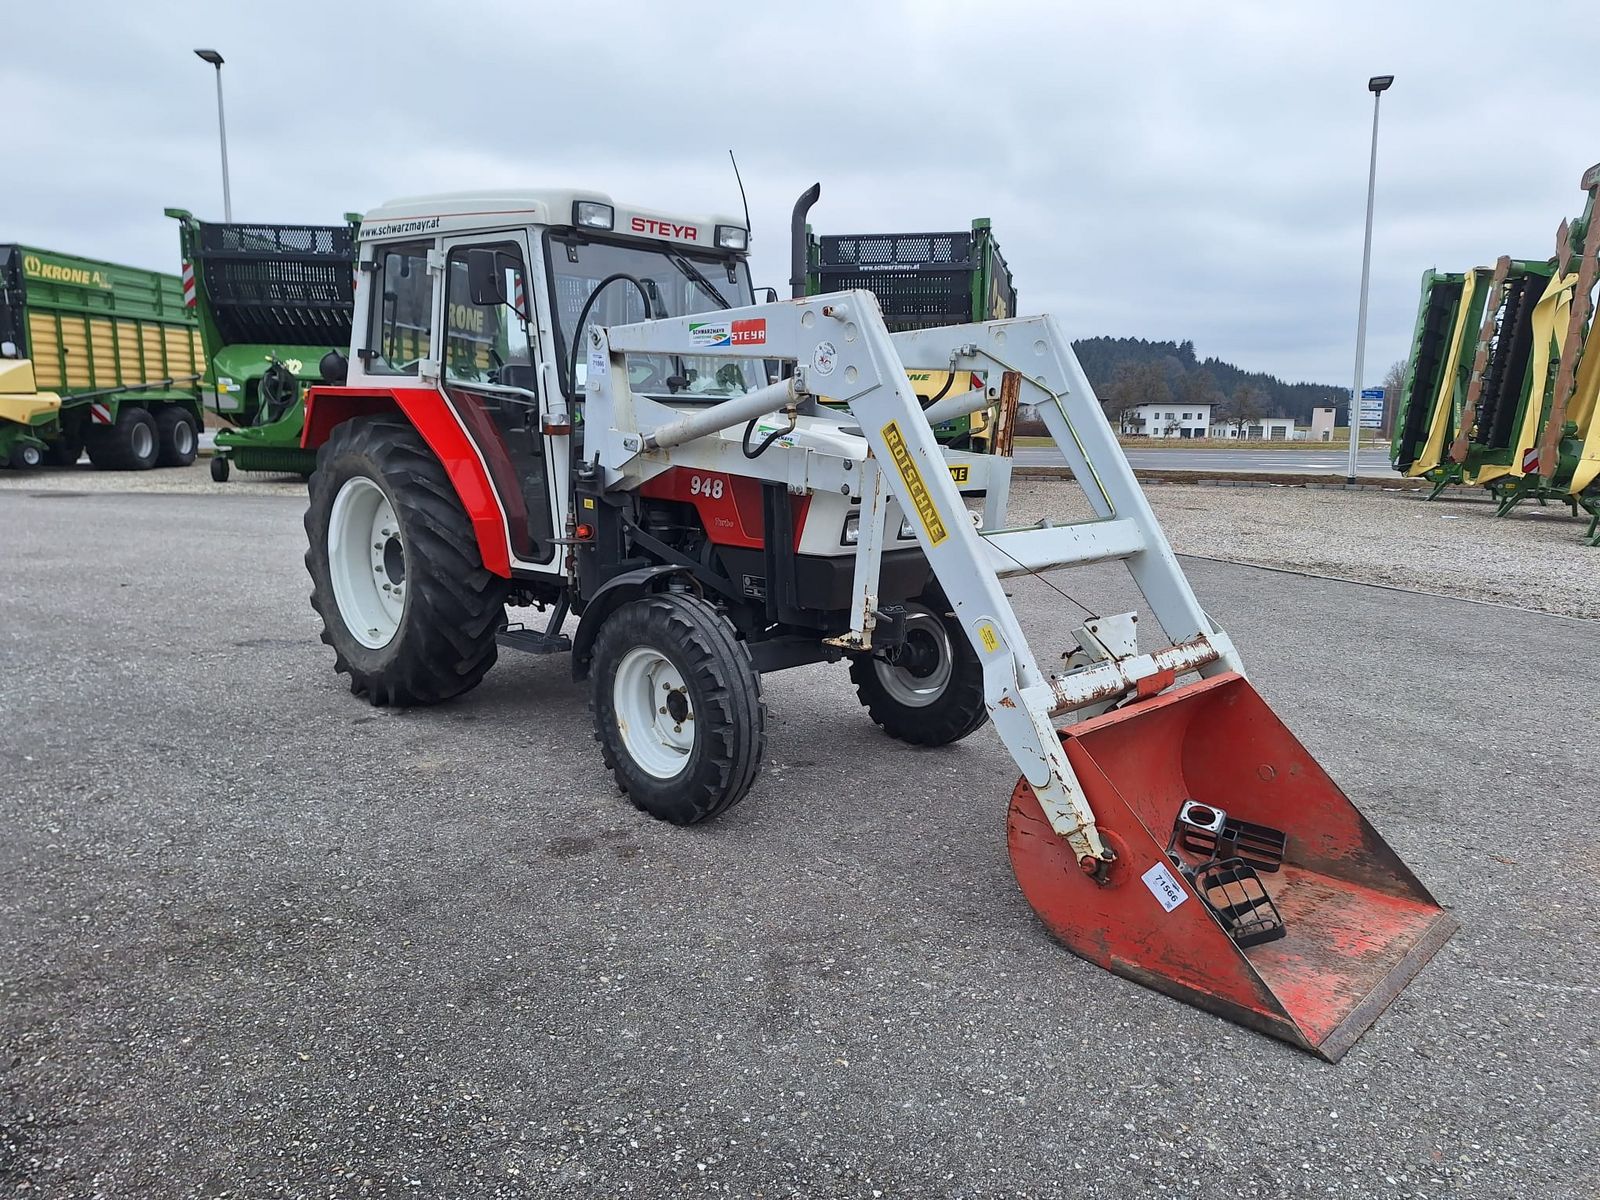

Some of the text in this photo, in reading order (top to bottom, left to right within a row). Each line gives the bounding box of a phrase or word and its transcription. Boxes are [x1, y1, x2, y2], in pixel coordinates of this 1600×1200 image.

[360, 216, 440, 237] www.schwarzmayr.at
[631, 217, 697, 241] STEYR
[41, 263, 90, 285] KRONE
[448, 302, 484, 333] RONE
[731, 330, 765, 341] STEYR
[886, 428, 942, 539] ROTSCHNE
[951, 468, 966, 481] NE
[690, 475, 724, 499] 948
[714, 516, 734, 528] Turbo
[1155, 874, 1179, 902] 71566
